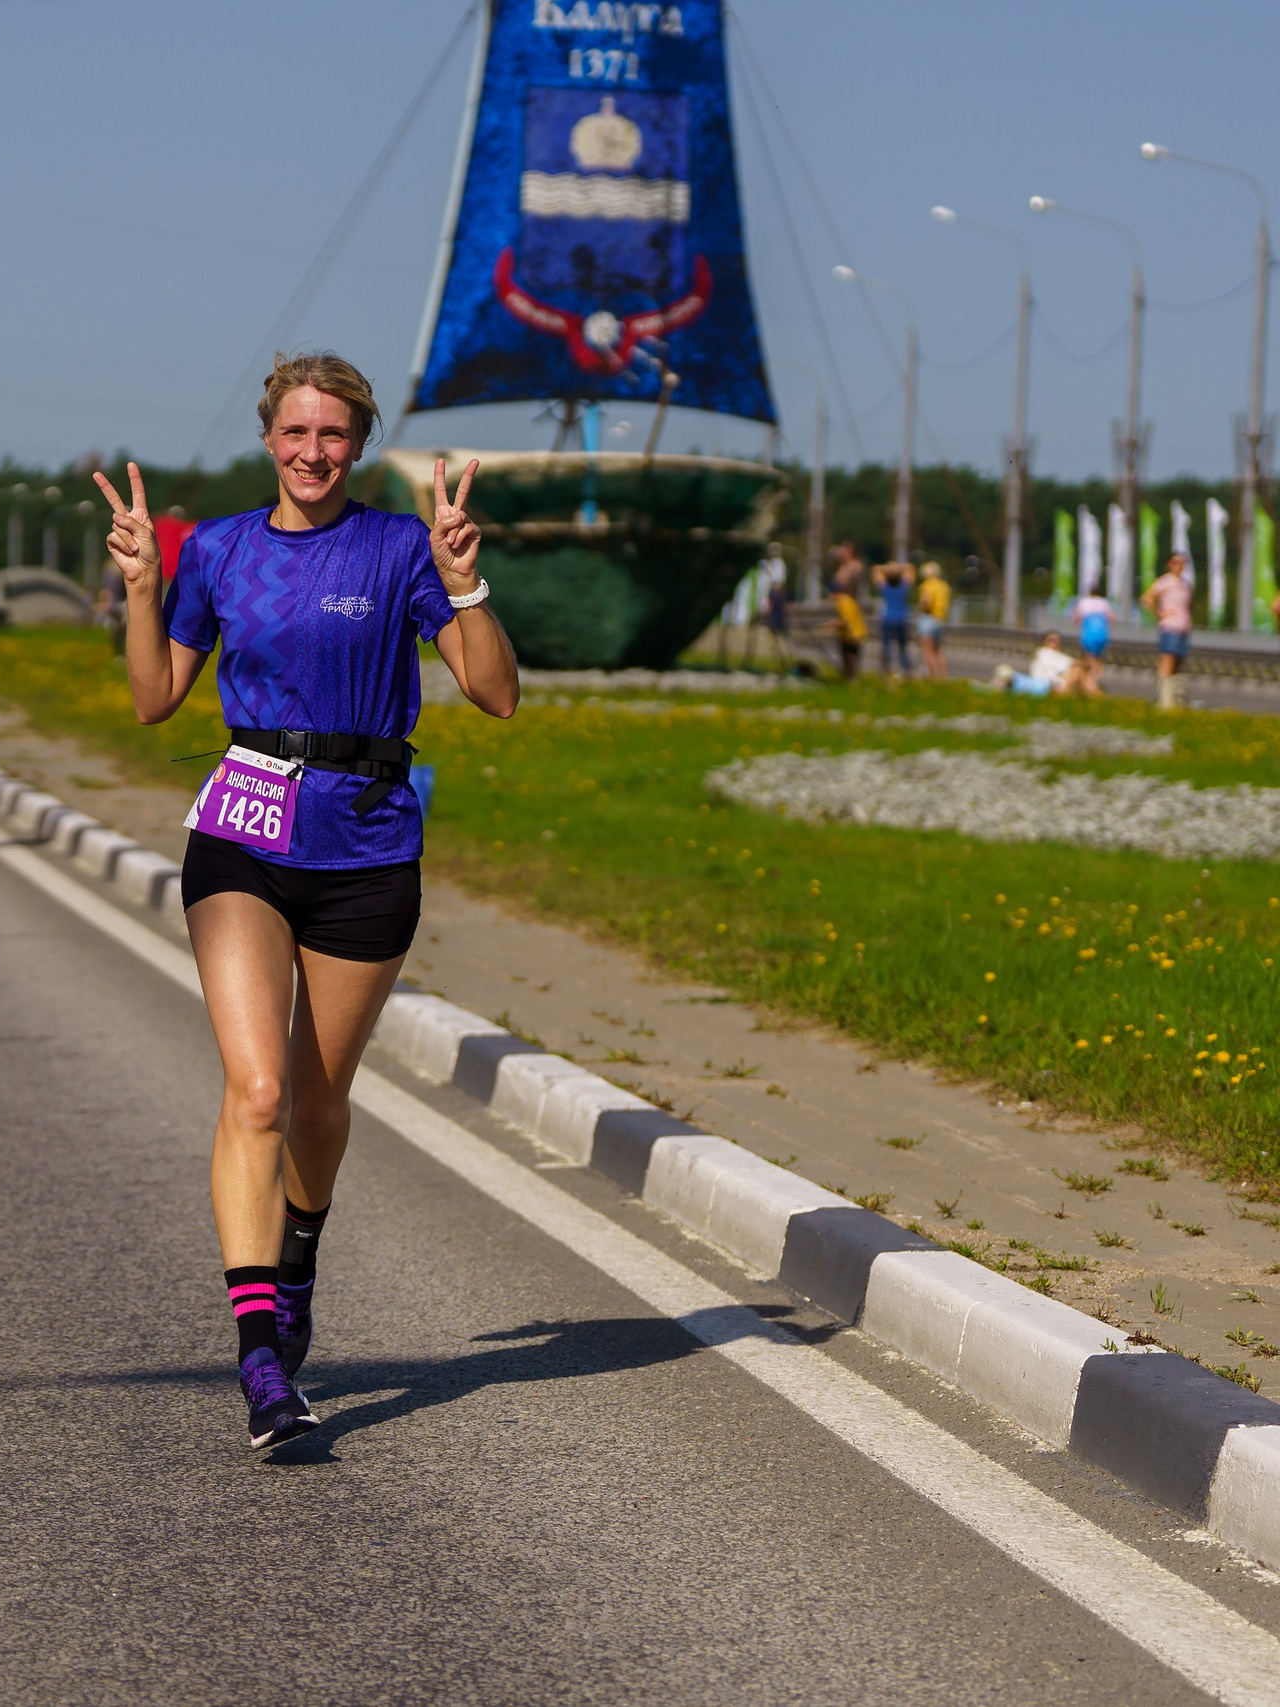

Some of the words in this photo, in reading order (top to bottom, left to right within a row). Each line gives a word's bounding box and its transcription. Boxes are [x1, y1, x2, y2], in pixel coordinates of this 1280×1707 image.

[568, 48, 639, 82] 1371
[225, 770, 286, 801] АНАСТАСИЯ
[216, 791, 283, 840] 1426
